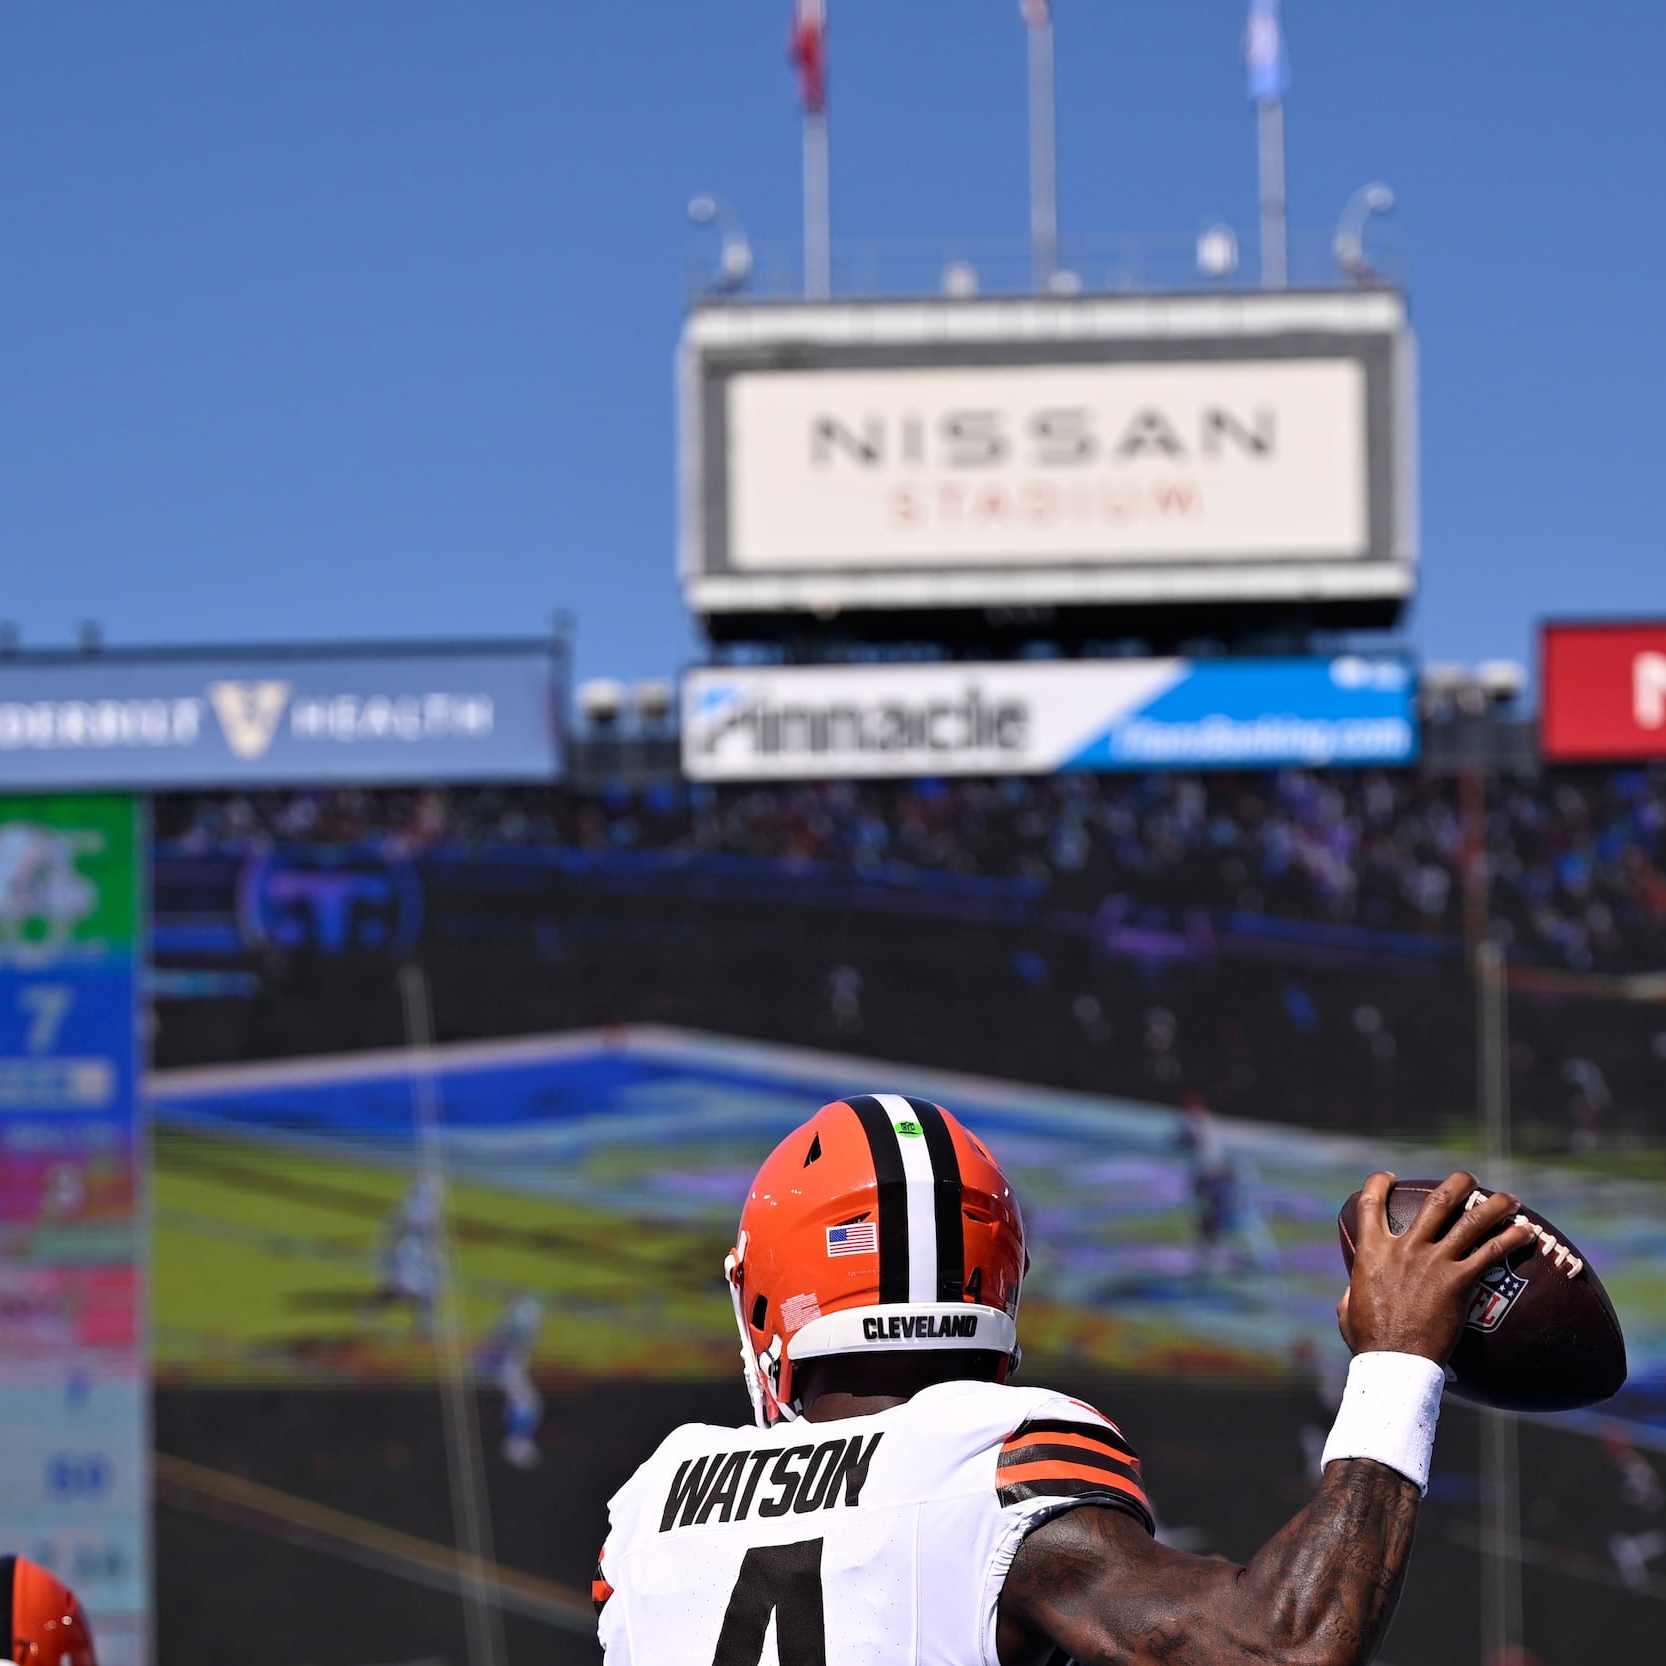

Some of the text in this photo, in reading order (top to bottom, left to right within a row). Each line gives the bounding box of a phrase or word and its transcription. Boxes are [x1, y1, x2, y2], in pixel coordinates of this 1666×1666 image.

[808, 408, 1278, 468] NISSAN
[888, 480, 1203, 529] STADIUM
[290, 693, 495, 739] HEALTH
[862, 1315, 978, 1340] CLEVELAND
[659, 1431, 885, 1532] WATSON
